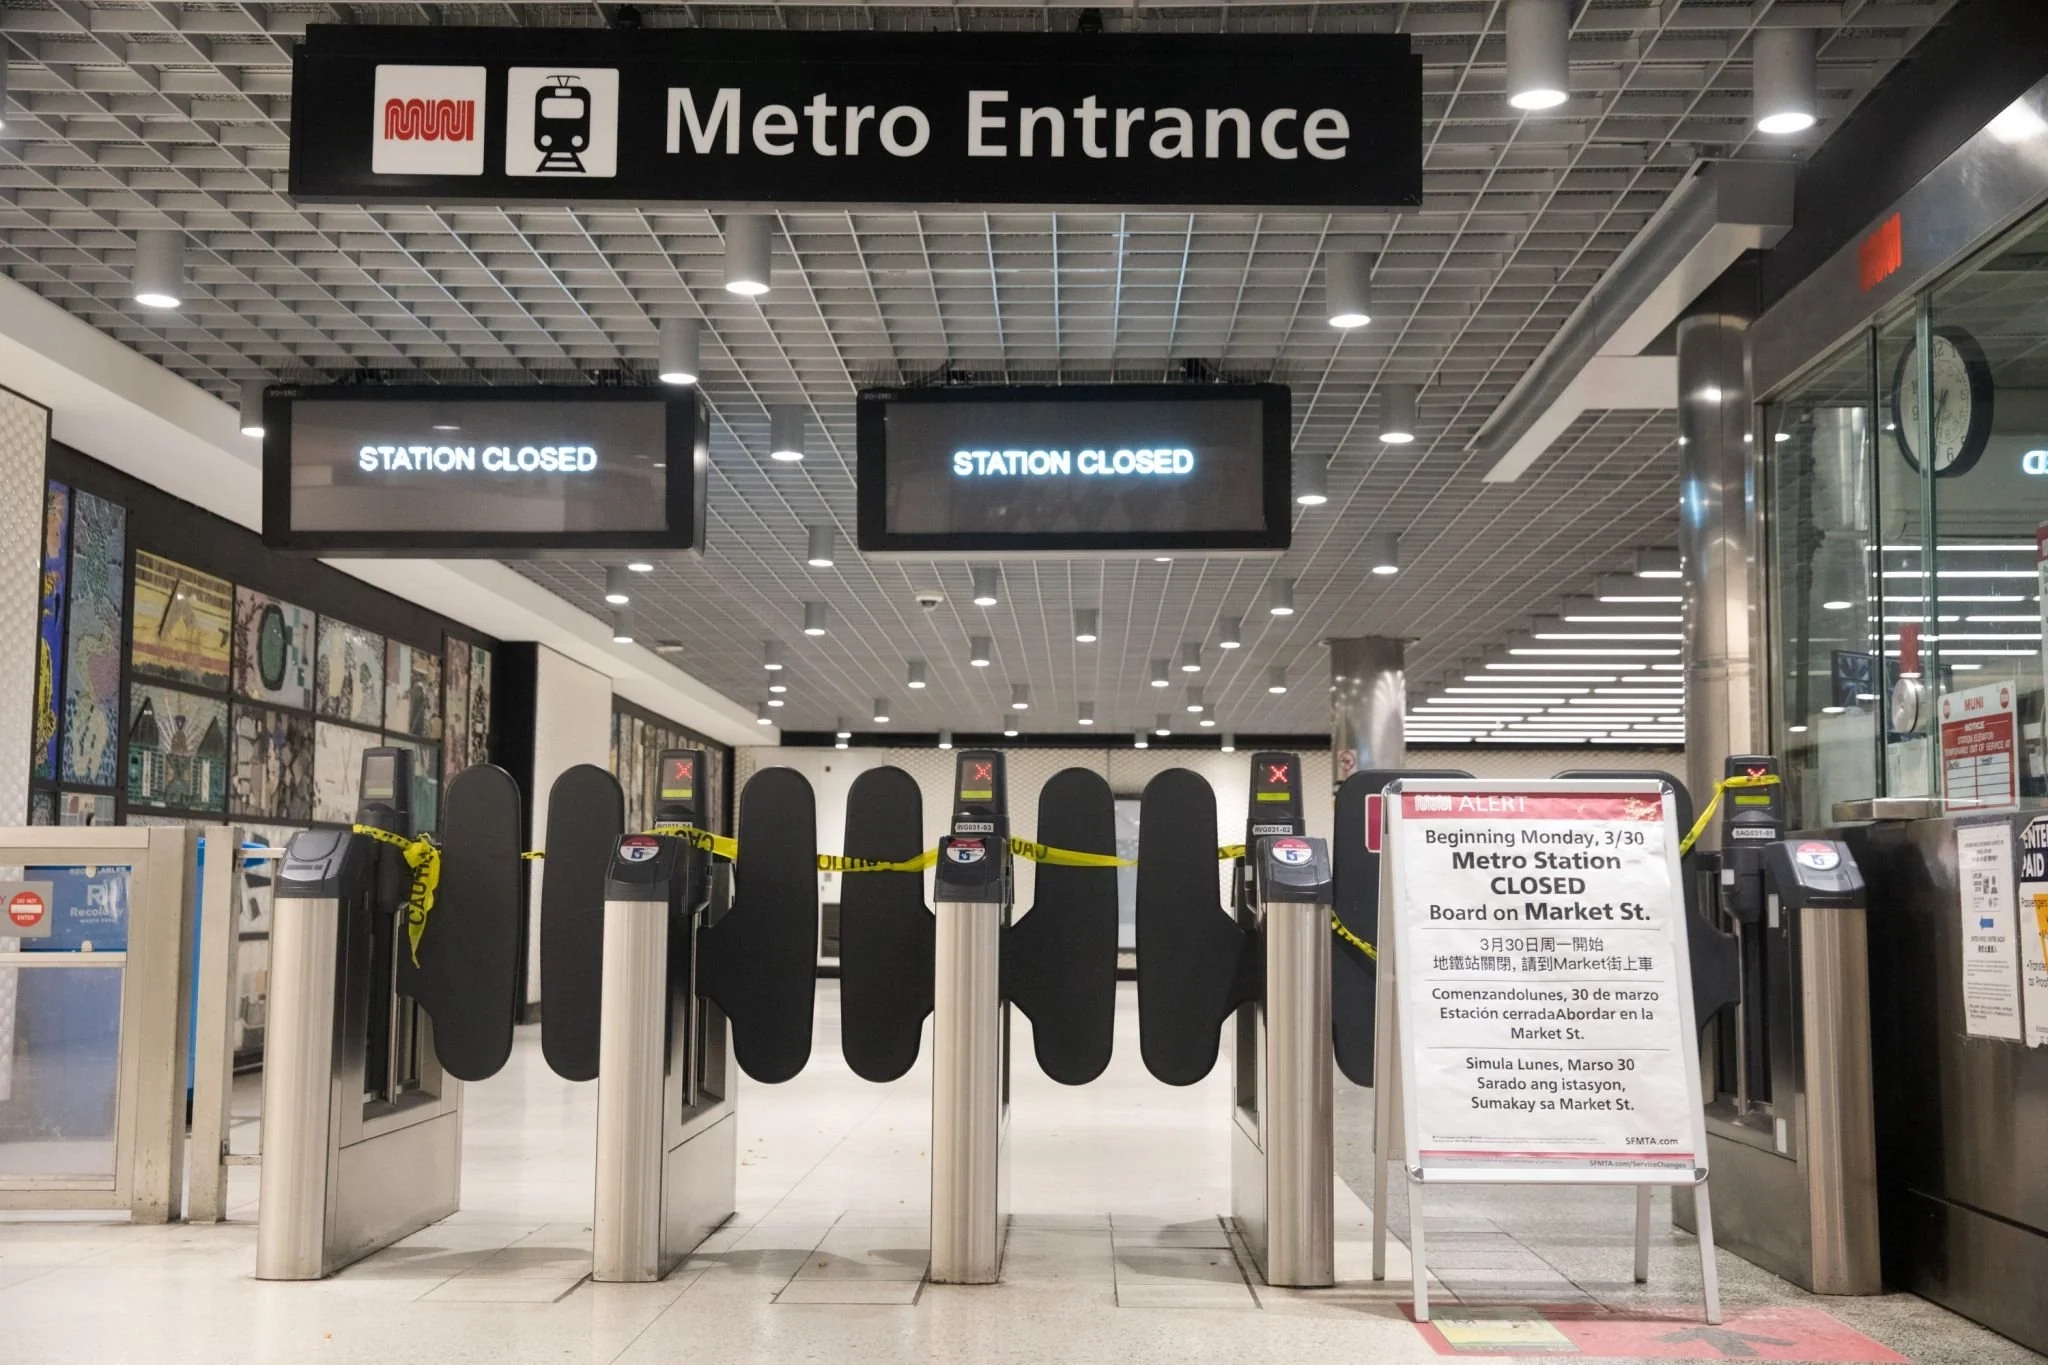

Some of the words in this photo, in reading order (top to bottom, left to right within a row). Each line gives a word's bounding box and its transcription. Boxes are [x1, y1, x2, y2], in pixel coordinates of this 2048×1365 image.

[666, 87, 931, 157] Metro
[967, 89, 1350, 160] Entrance
[359, 446, 475, 472] STATION
[482, 446, 597, 472] CLOSED
[952, 449, 1071, 476] STATION
[1077, 448, 1195, 475] CLOSED
[1963, 696, 1984, 711] MUNI
[1458, 795, 1528, 812] ALERT
[1425, 829, 1515, 848] Beginning
[1521, 829, 1599, 848] Monday,
[1604, 830, 1645, 849] 3/30
[1452, 851, 1527, 870] Metro
[1534, 851, 1621, 870] Station
[1490, 876, 1586, 895] CLOSED
[1430, 904, 1487, 921] Board
[1493, 907, 1519, 921] on
[1525, 902, 1614, 921] Market
[1619, 902, 1651, 921] St.
[1480, 936, 1604, 953] 3月30日周一開始
[1432, 988, 1567, 1002] Comenzandolunes,
[1571, 988, 1589, 1001] 30
[1593, 988, 1611, 1001] de
[1615, 991, 1659, 1002] marzo
[1440, 1007, 1499, 1019] Estación
[1503, 1008, 1616, 1020] cerradaAbordar
[1620, 1010, 1638, 1020] en
[1641, 1008, 1654, 1020] la
[1511, 1027, 1562, 1040] Market
[1566, 1027, 1585, 1040] St.
[1466, 1057, 1514, 1070] Simula
[1517, 1058, 1563, 1072] Lunes,
[1568, 1059, 1613, 1071] Marso
[1617, 1058, 1635, 1071] 30
[1477, 1077, 1526, 1090] Sarado
[1531, 1080, 1558, 1093] ang
[1562, 1078, 1626, 1094] istasyon,
[1471, 1096, 1536, 1112] Sumakay
[1540, 1101, 1555, 1110] sa
[1560, 1098, 1612, 1111] Market
[1615, 1098, 1635, 1111] St.
[1625, 1136, 1679, 1146] SFMTA.com
